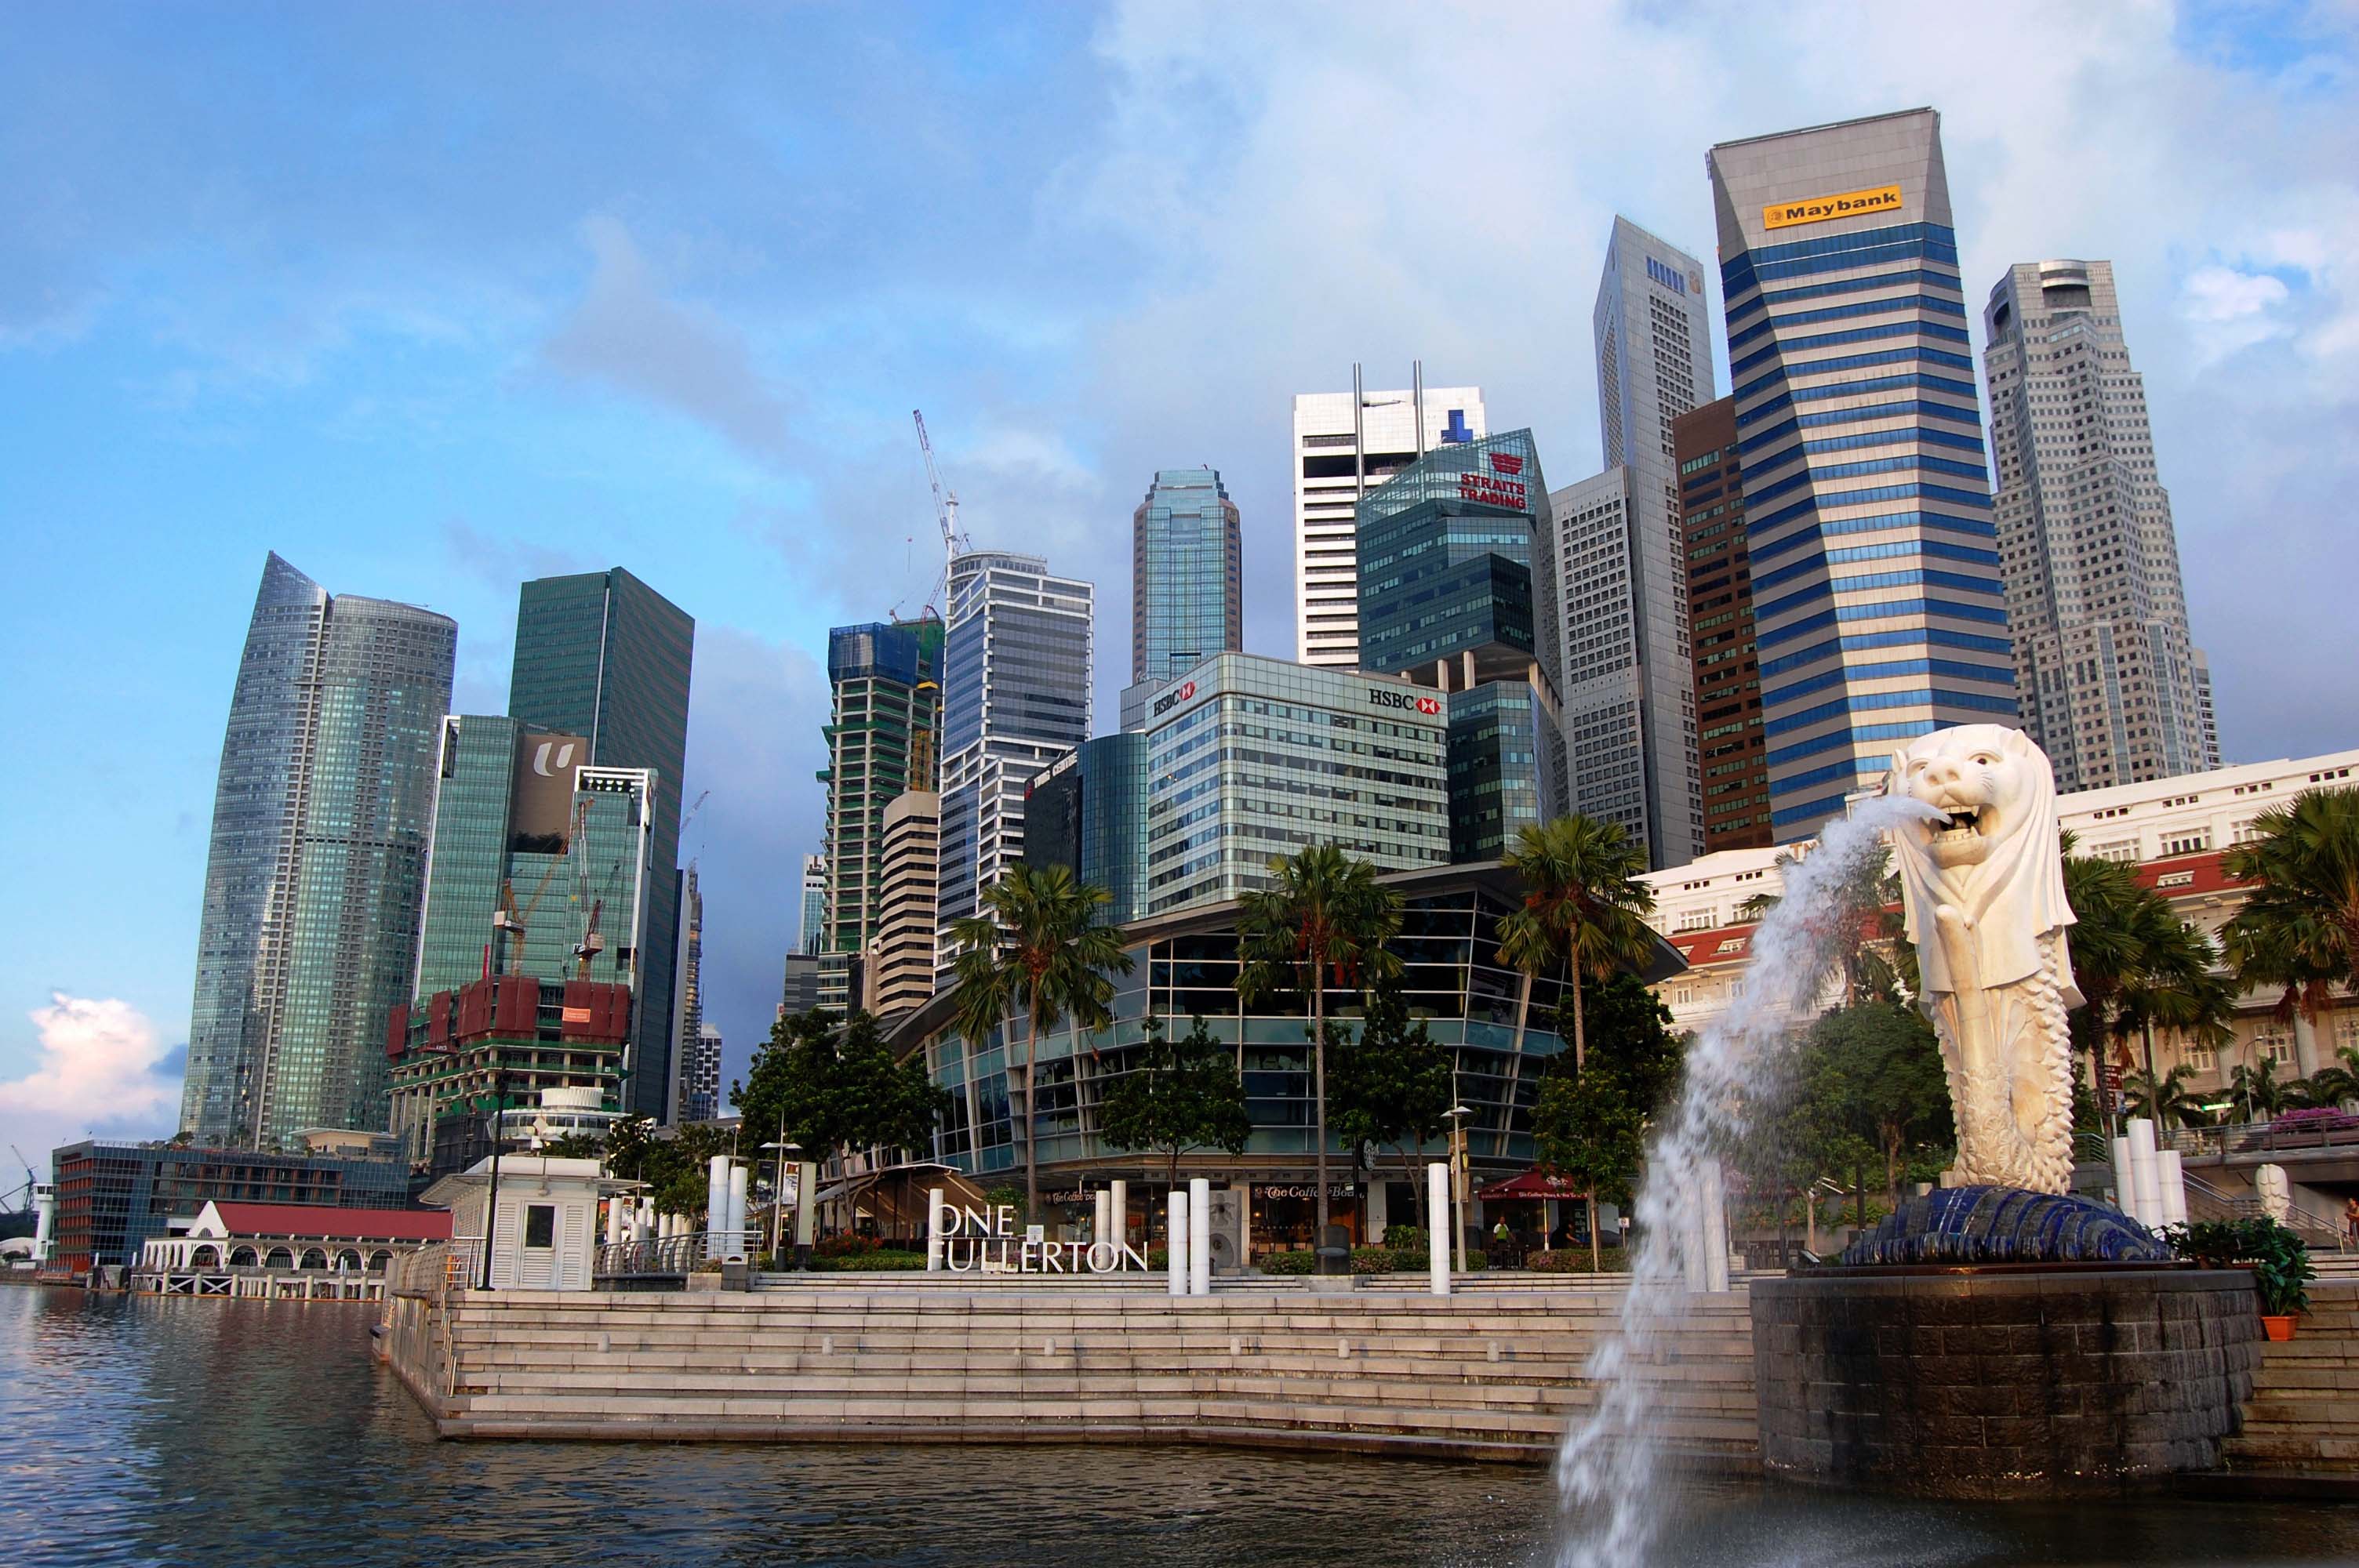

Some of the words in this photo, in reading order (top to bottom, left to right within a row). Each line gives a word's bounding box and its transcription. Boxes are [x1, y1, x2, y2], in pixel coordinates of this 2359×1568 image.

[1787, 192, 1897, 220] Maybank
[1460, 473, 1525, 495] STRAITS
[1457, 486, 1527, 510] TRADING
[1154, 689, 1180, 717] HSBC
[1369, 688, 1414, 710] HSBC
[1264, 1186, 1288, 1200] The
[934, 1203, 1014, 1236] ONE
[928, 1241, 1147, 1273] FULLERTON
